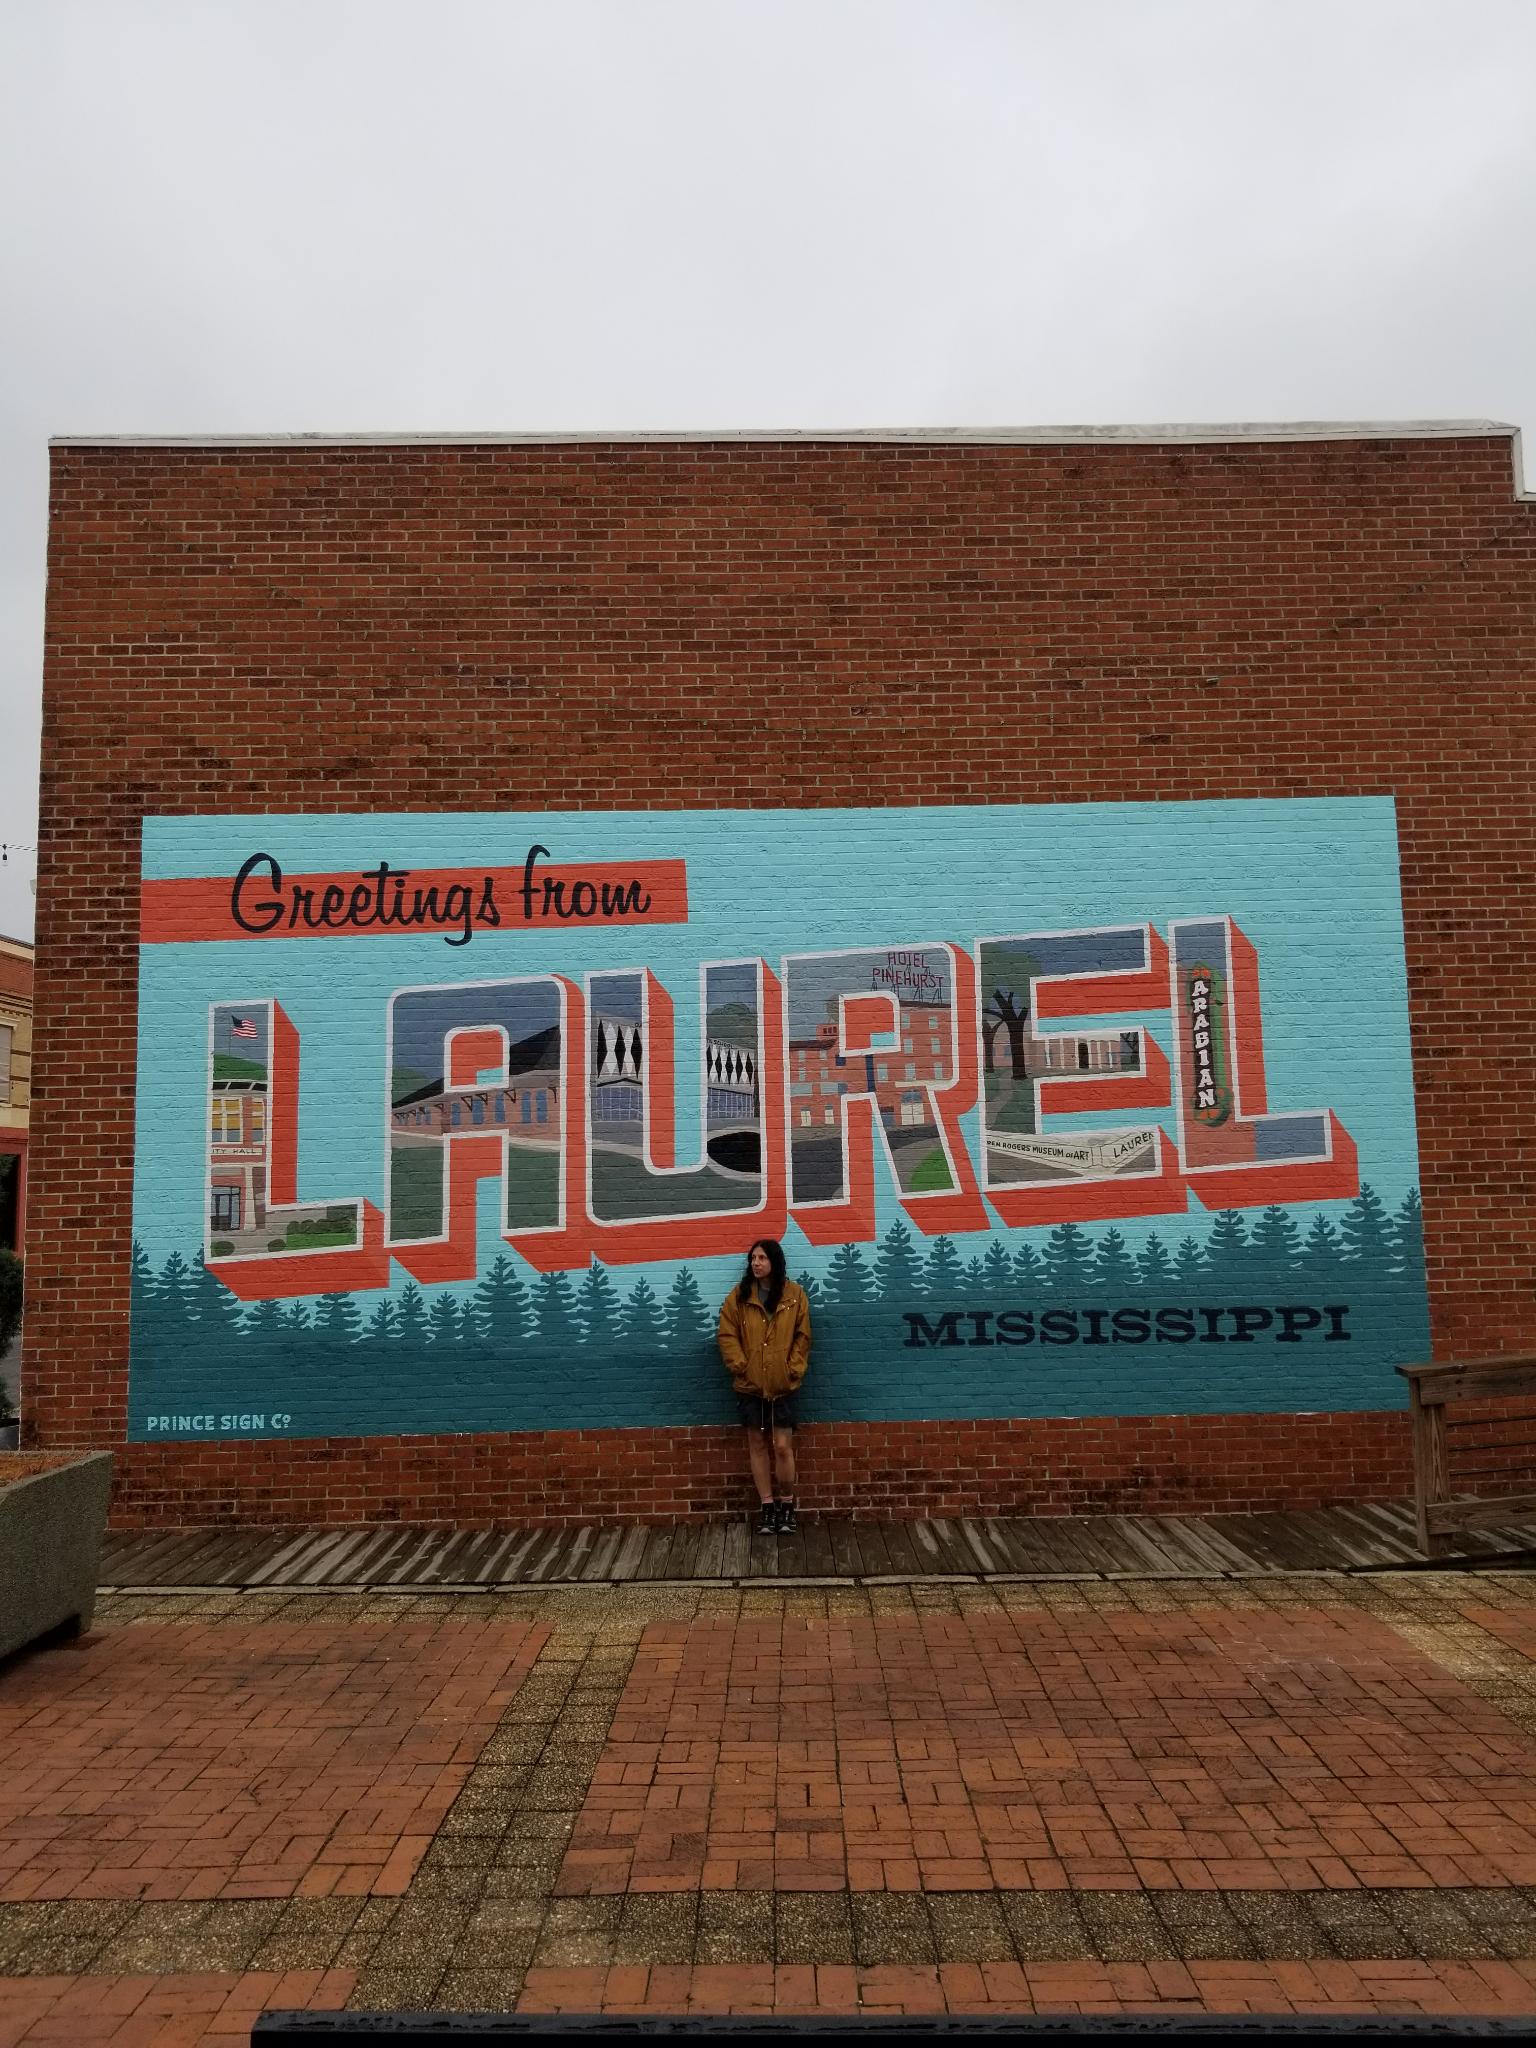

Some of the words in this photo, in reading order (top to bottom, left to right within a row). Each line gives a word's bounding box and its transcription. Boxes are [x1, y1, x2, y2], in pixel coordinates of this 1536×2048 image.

[230, 852, 501, 947] Greetings
[518, 844, 652, 920] from
[887, 951, 930, 969] HOTEL
[872, 966, 945, 989] PINEHURST
[1191, 980, 1216, 1109] ARABIAN
[204, 915, 1359, 1301] LAUREL
[1002, 1143, 1031, 1152] ROGERS
[1032, 1146, 1064, 1158] MUSEUM
[1073, 1150, 1090, 1161] ART
[902, 1304, 1352, 1348] MISSISSIPPI
[147, 1415, 215, 1431] PRINCE
[220, 1414, 265, 1430] SIGN
